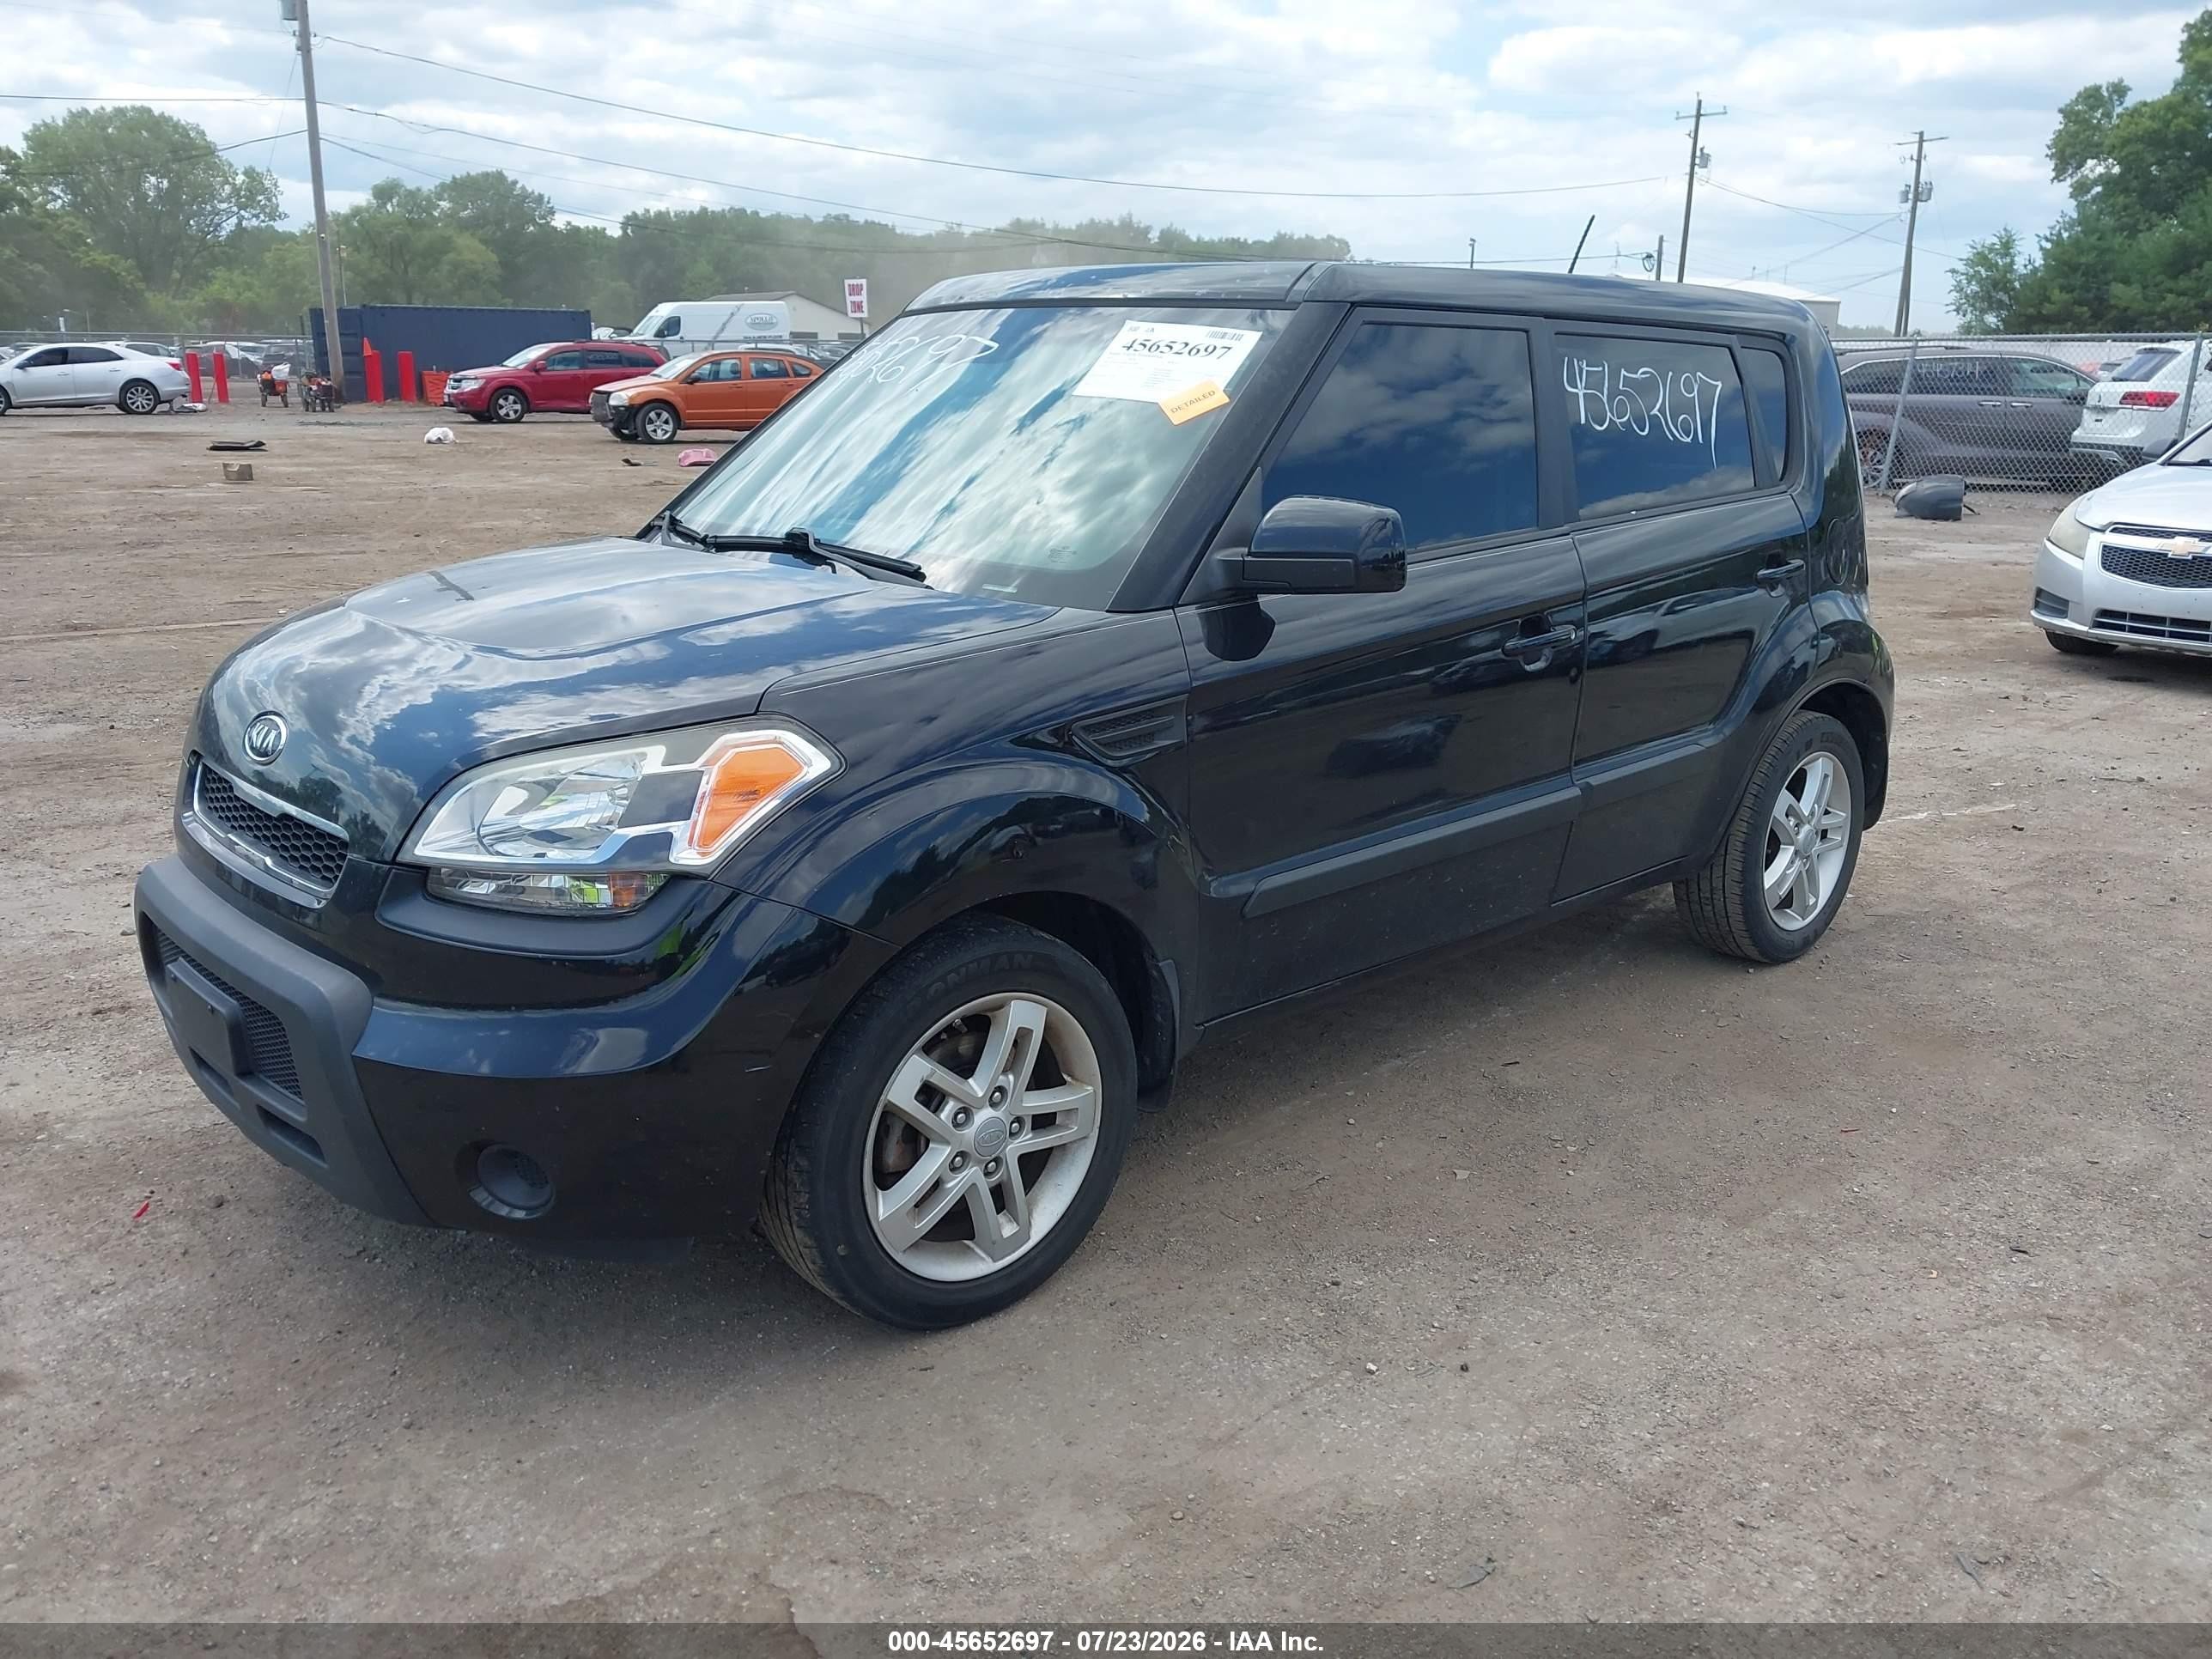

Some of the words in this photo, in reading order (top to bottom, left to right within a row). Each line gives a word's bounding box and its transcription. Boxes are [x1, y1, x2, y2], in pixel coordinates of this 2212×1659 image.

[848, 283, 863, 296] DROP
[850, 301, 864, 313] ZONE
[1122, 337, 1233, 360] 45652697
[1170, 390, 1216, 414] DETAILED
[1563, 356, 1723, 470] 45652697
